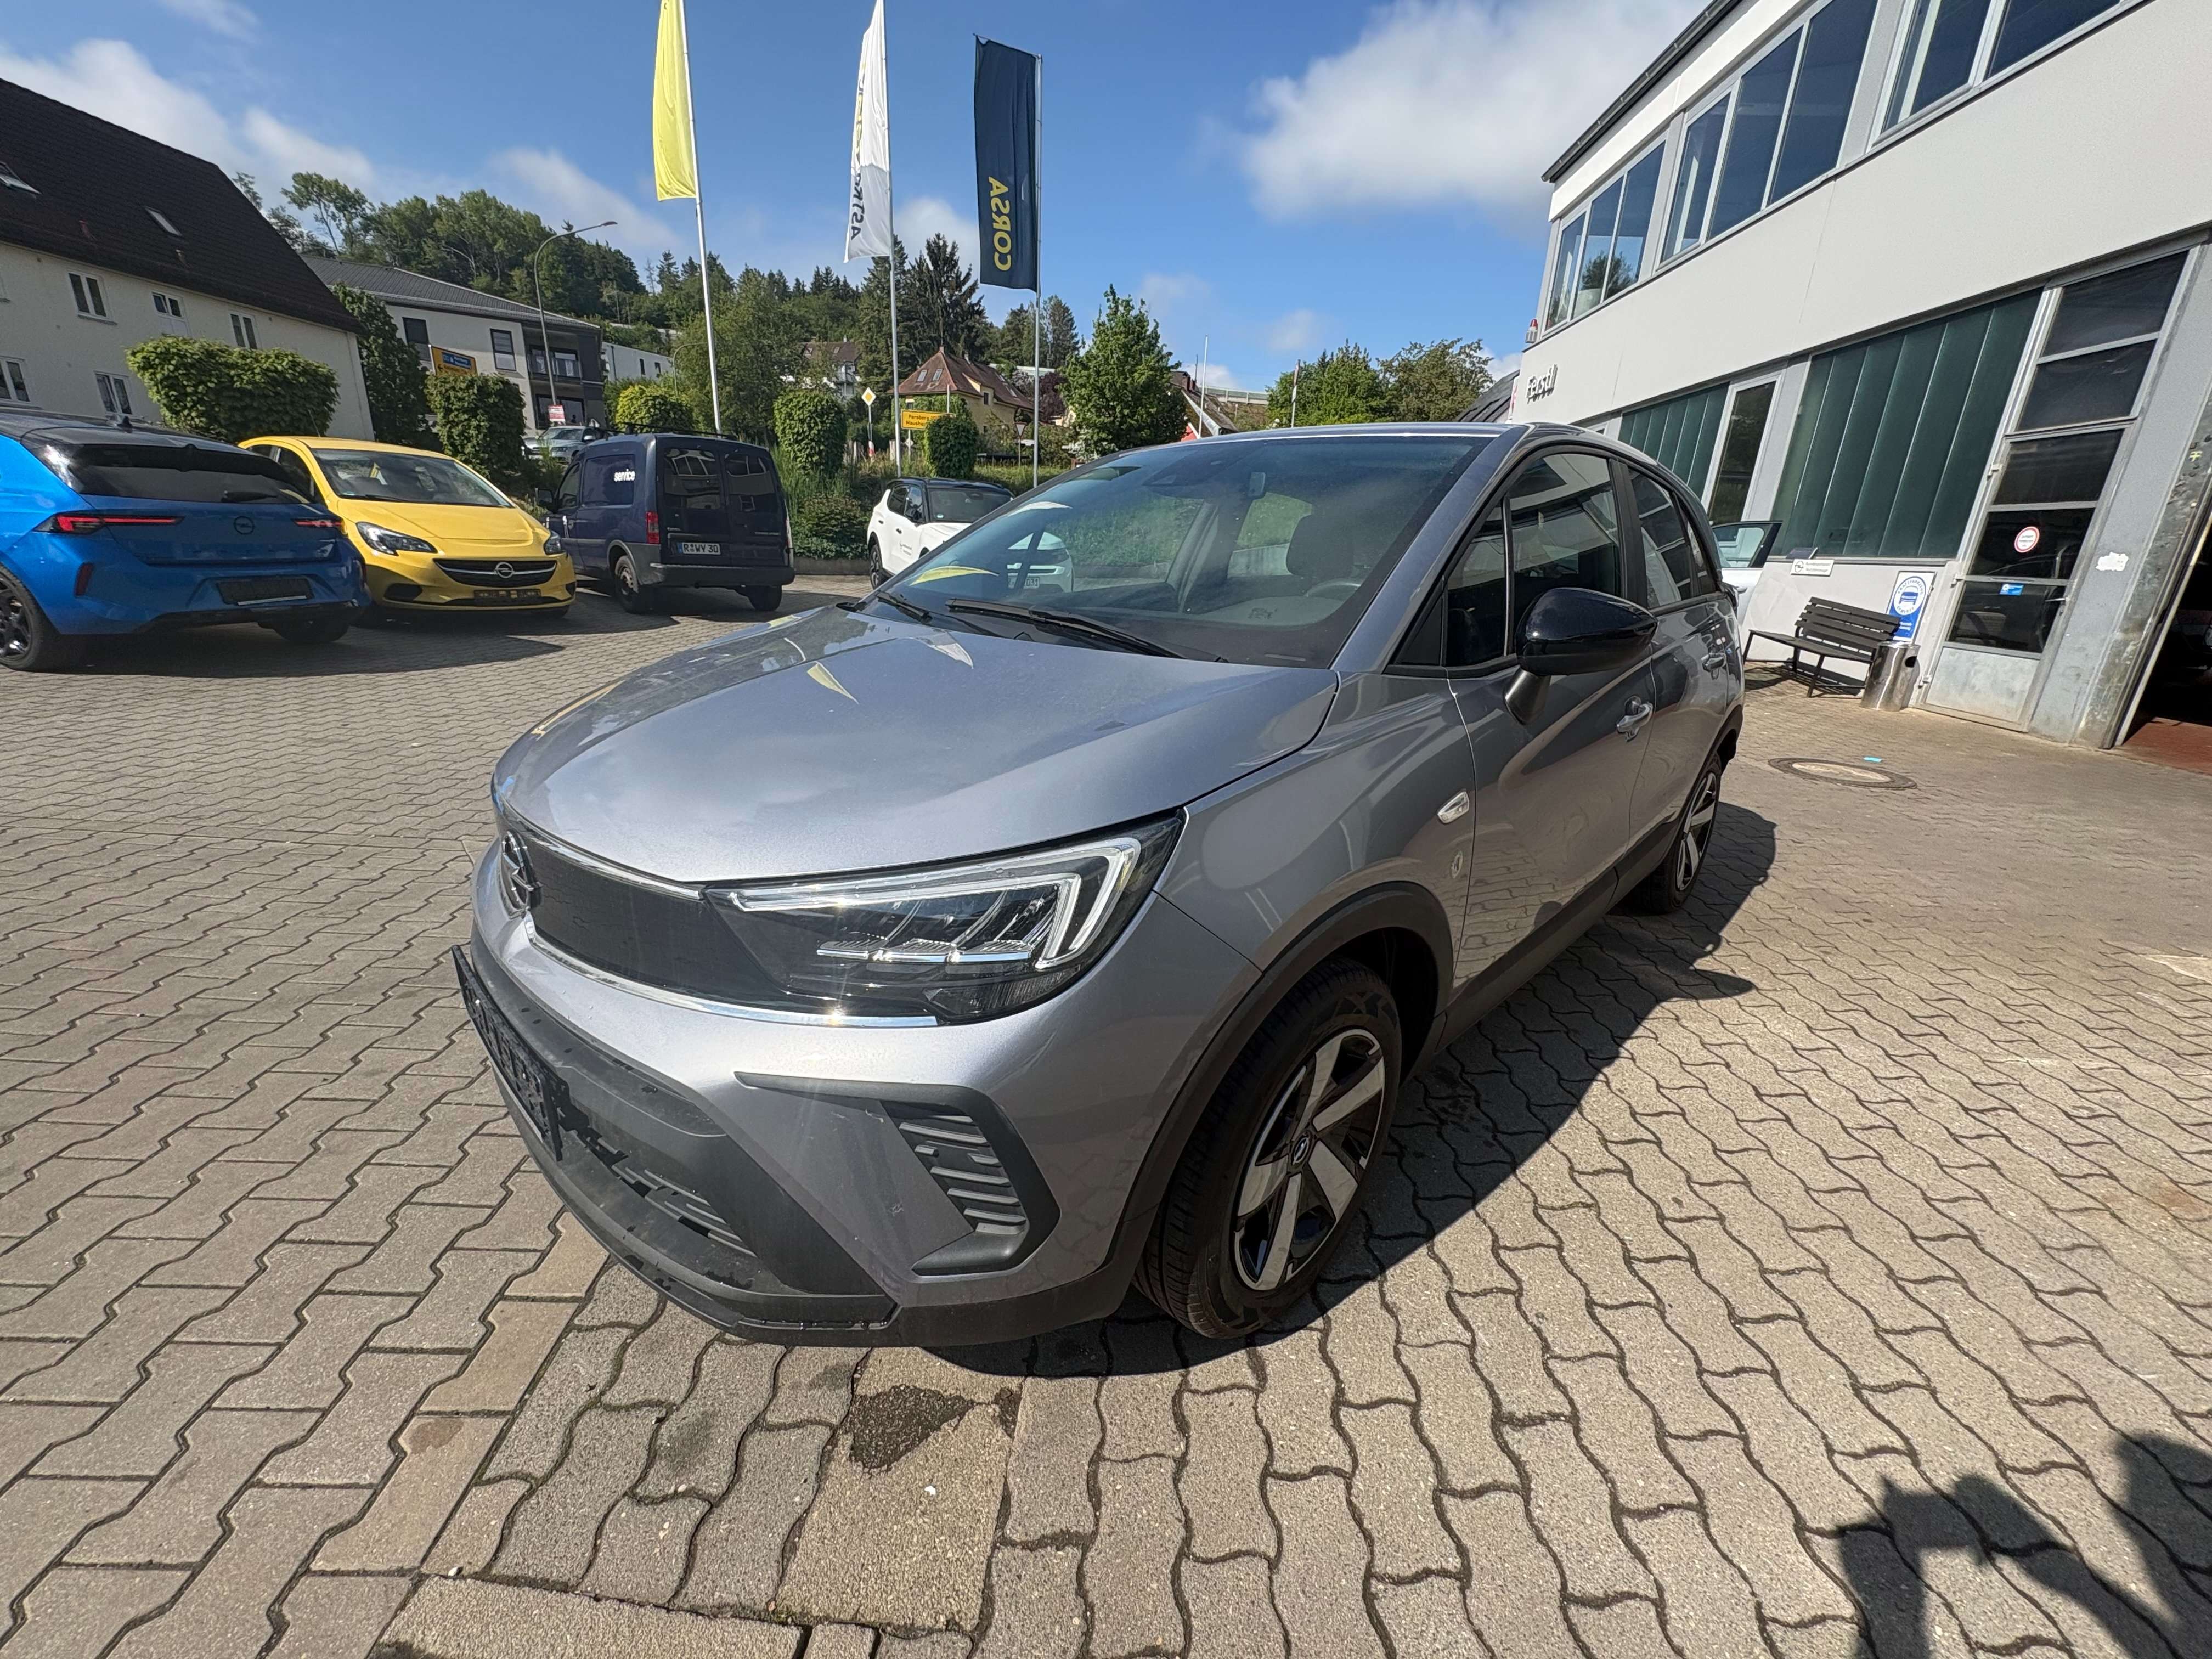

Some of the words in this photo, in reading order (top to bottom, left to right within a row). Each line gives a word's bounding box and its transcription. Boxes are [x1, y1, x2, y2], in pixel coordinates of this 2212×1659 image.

[1525, 364, 1558, 398] Ferstl
[614, 469, 635, 482] service
[708, 545, 719, 553] 30
